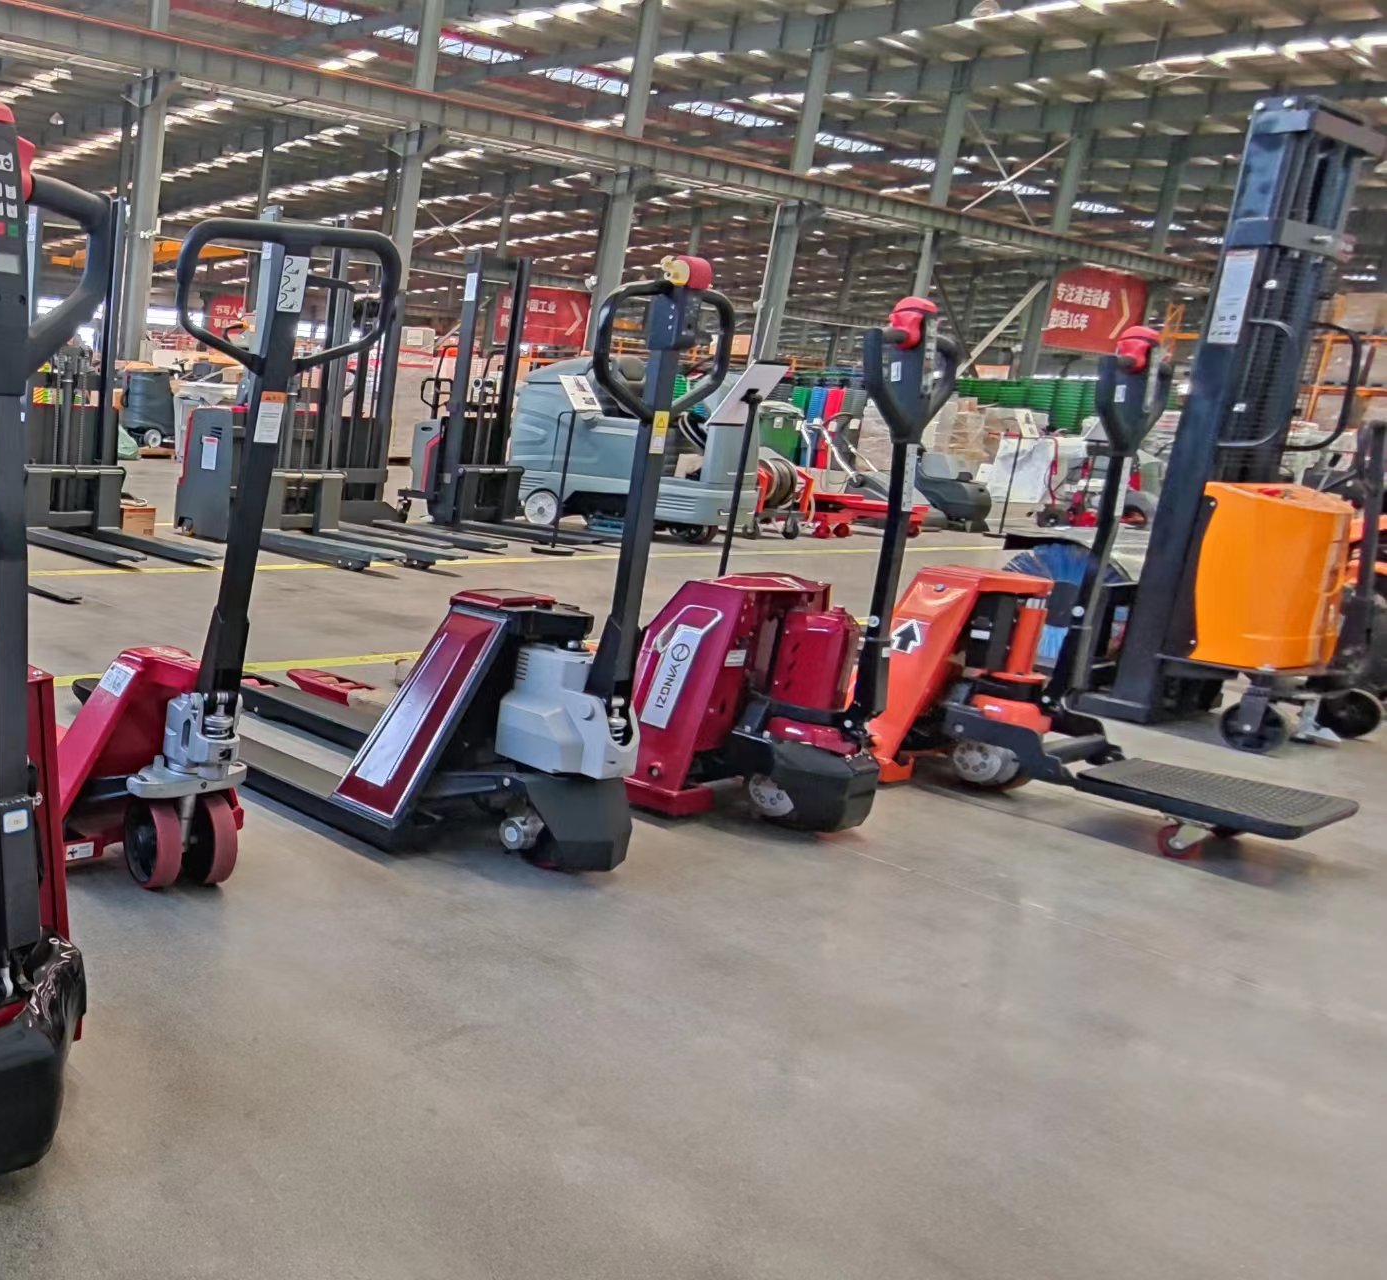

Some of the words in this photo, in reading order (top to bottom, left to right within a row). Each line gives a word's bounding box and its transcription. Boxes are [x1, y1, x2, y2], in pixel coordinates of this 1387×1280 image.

[1056, 282, 1111, 309] 专注清洁设备
[1048, 308, 1089, 331] 制造16年
[655, 663, 681, 708] YANGZI
